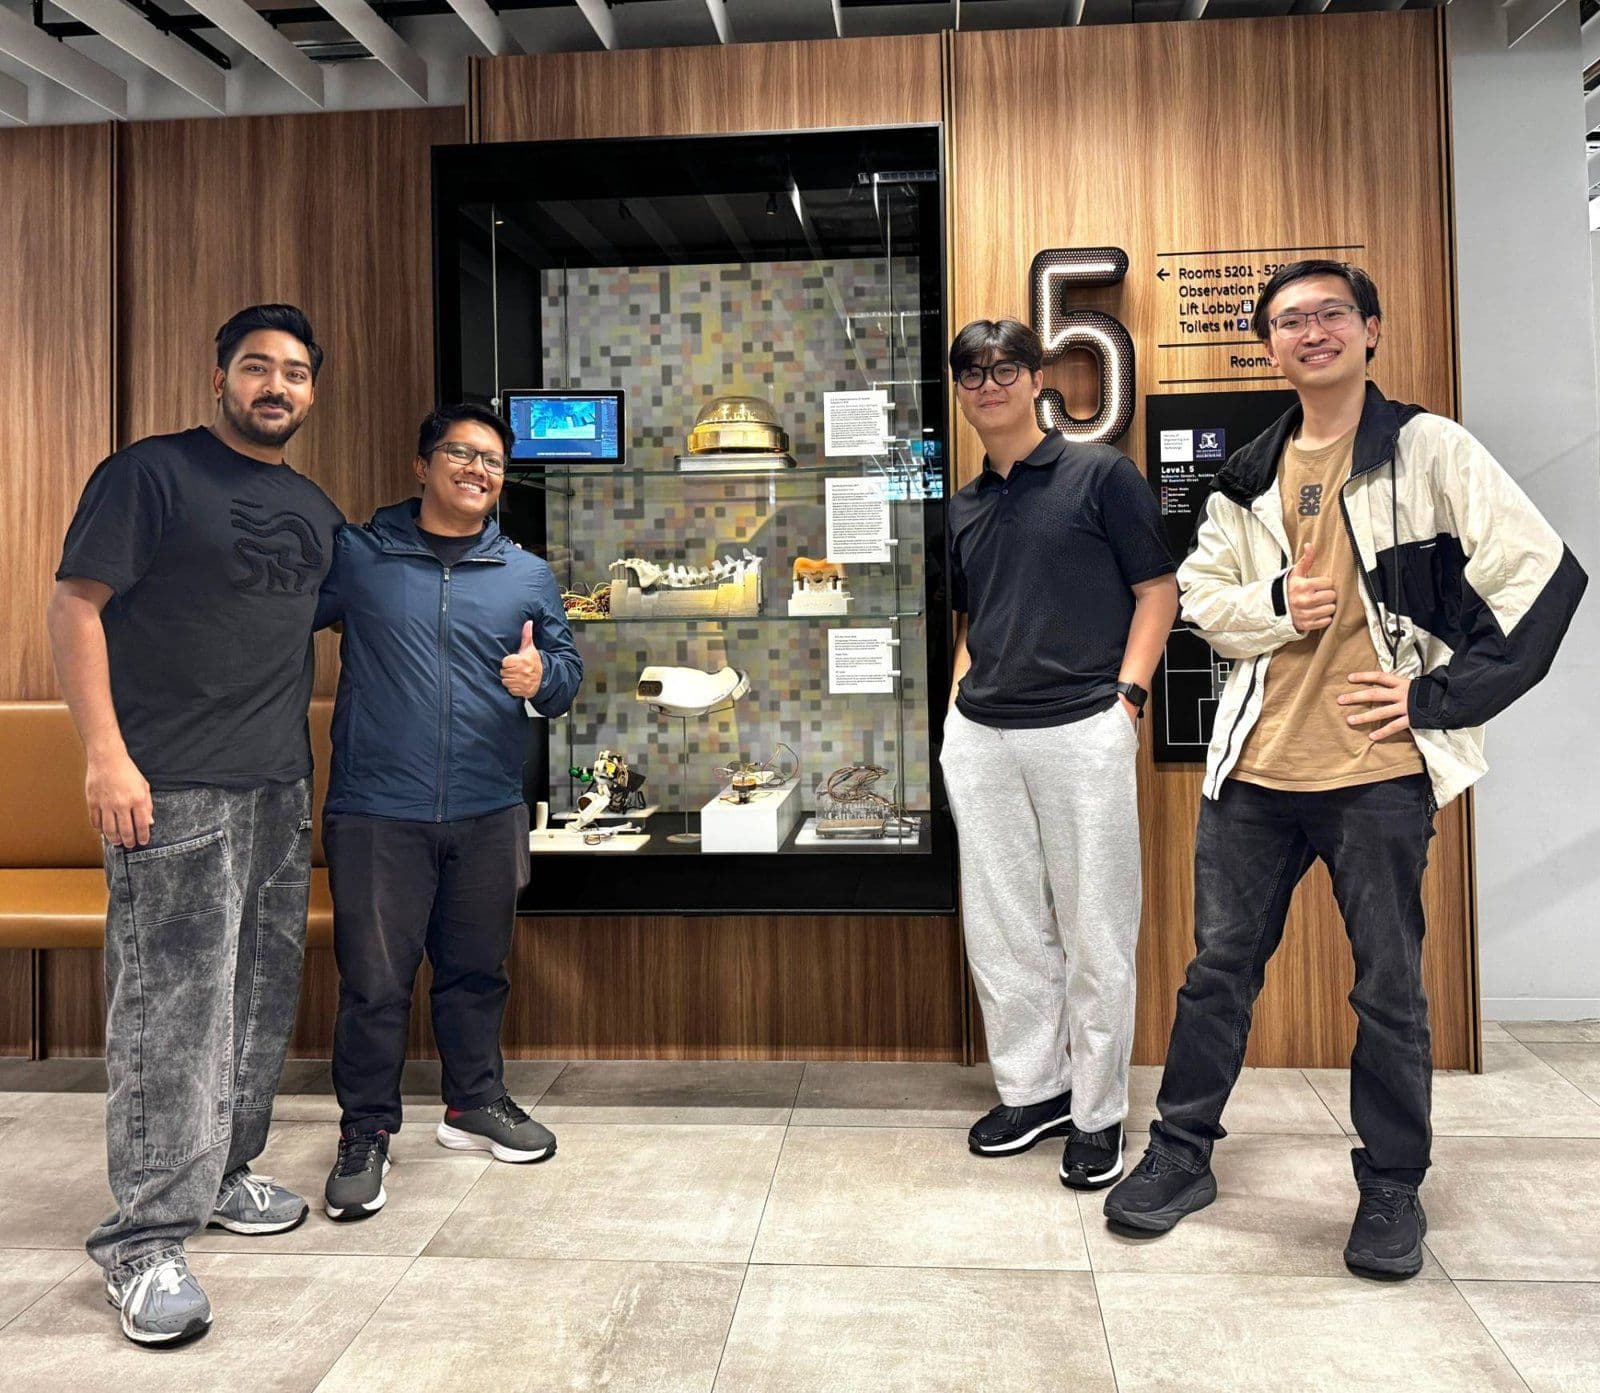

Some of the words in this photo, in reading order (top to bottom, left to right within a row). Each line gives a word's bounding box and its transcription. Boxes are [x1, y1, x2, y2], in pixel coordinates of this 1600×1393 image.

[1179, 268, 1222, 279] Rooms
[1224, 265, 1254, 278] 5201
[1179, 283, 1255, 298] Observation
[1179, 301, 1199, 316] Lift
[1202, 301, 1240, 316] Lobby
[1179, 319, 1220, 333] Toilets
[1031, 246, 1136, 445] 5
[1161, 465, 1185, 473] Level
